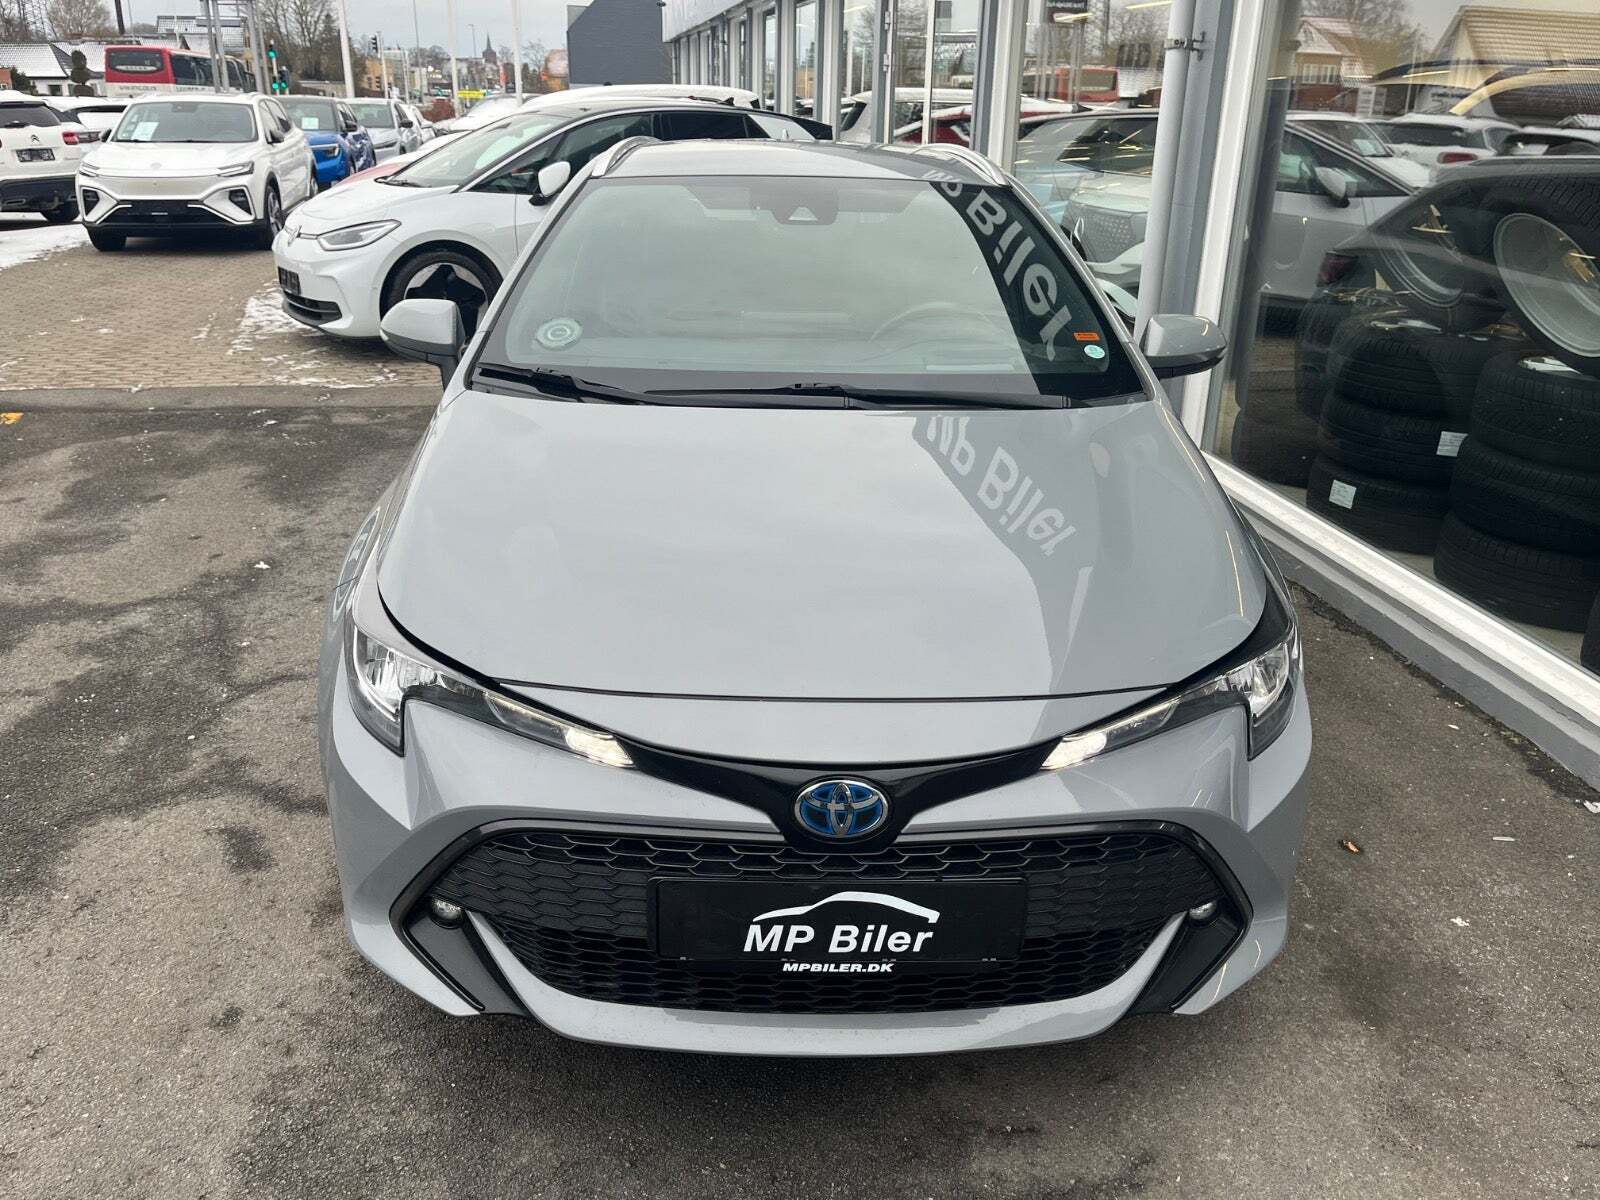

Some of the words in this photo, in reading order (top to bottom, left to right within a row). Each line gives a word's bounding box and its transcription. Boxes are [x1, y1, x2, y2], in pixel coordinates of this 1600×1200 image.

[743, 924, 815, 952] MP
[828, 924, 934, 953] Biler
[782, 963, 895, 973] MPBILER.DK
